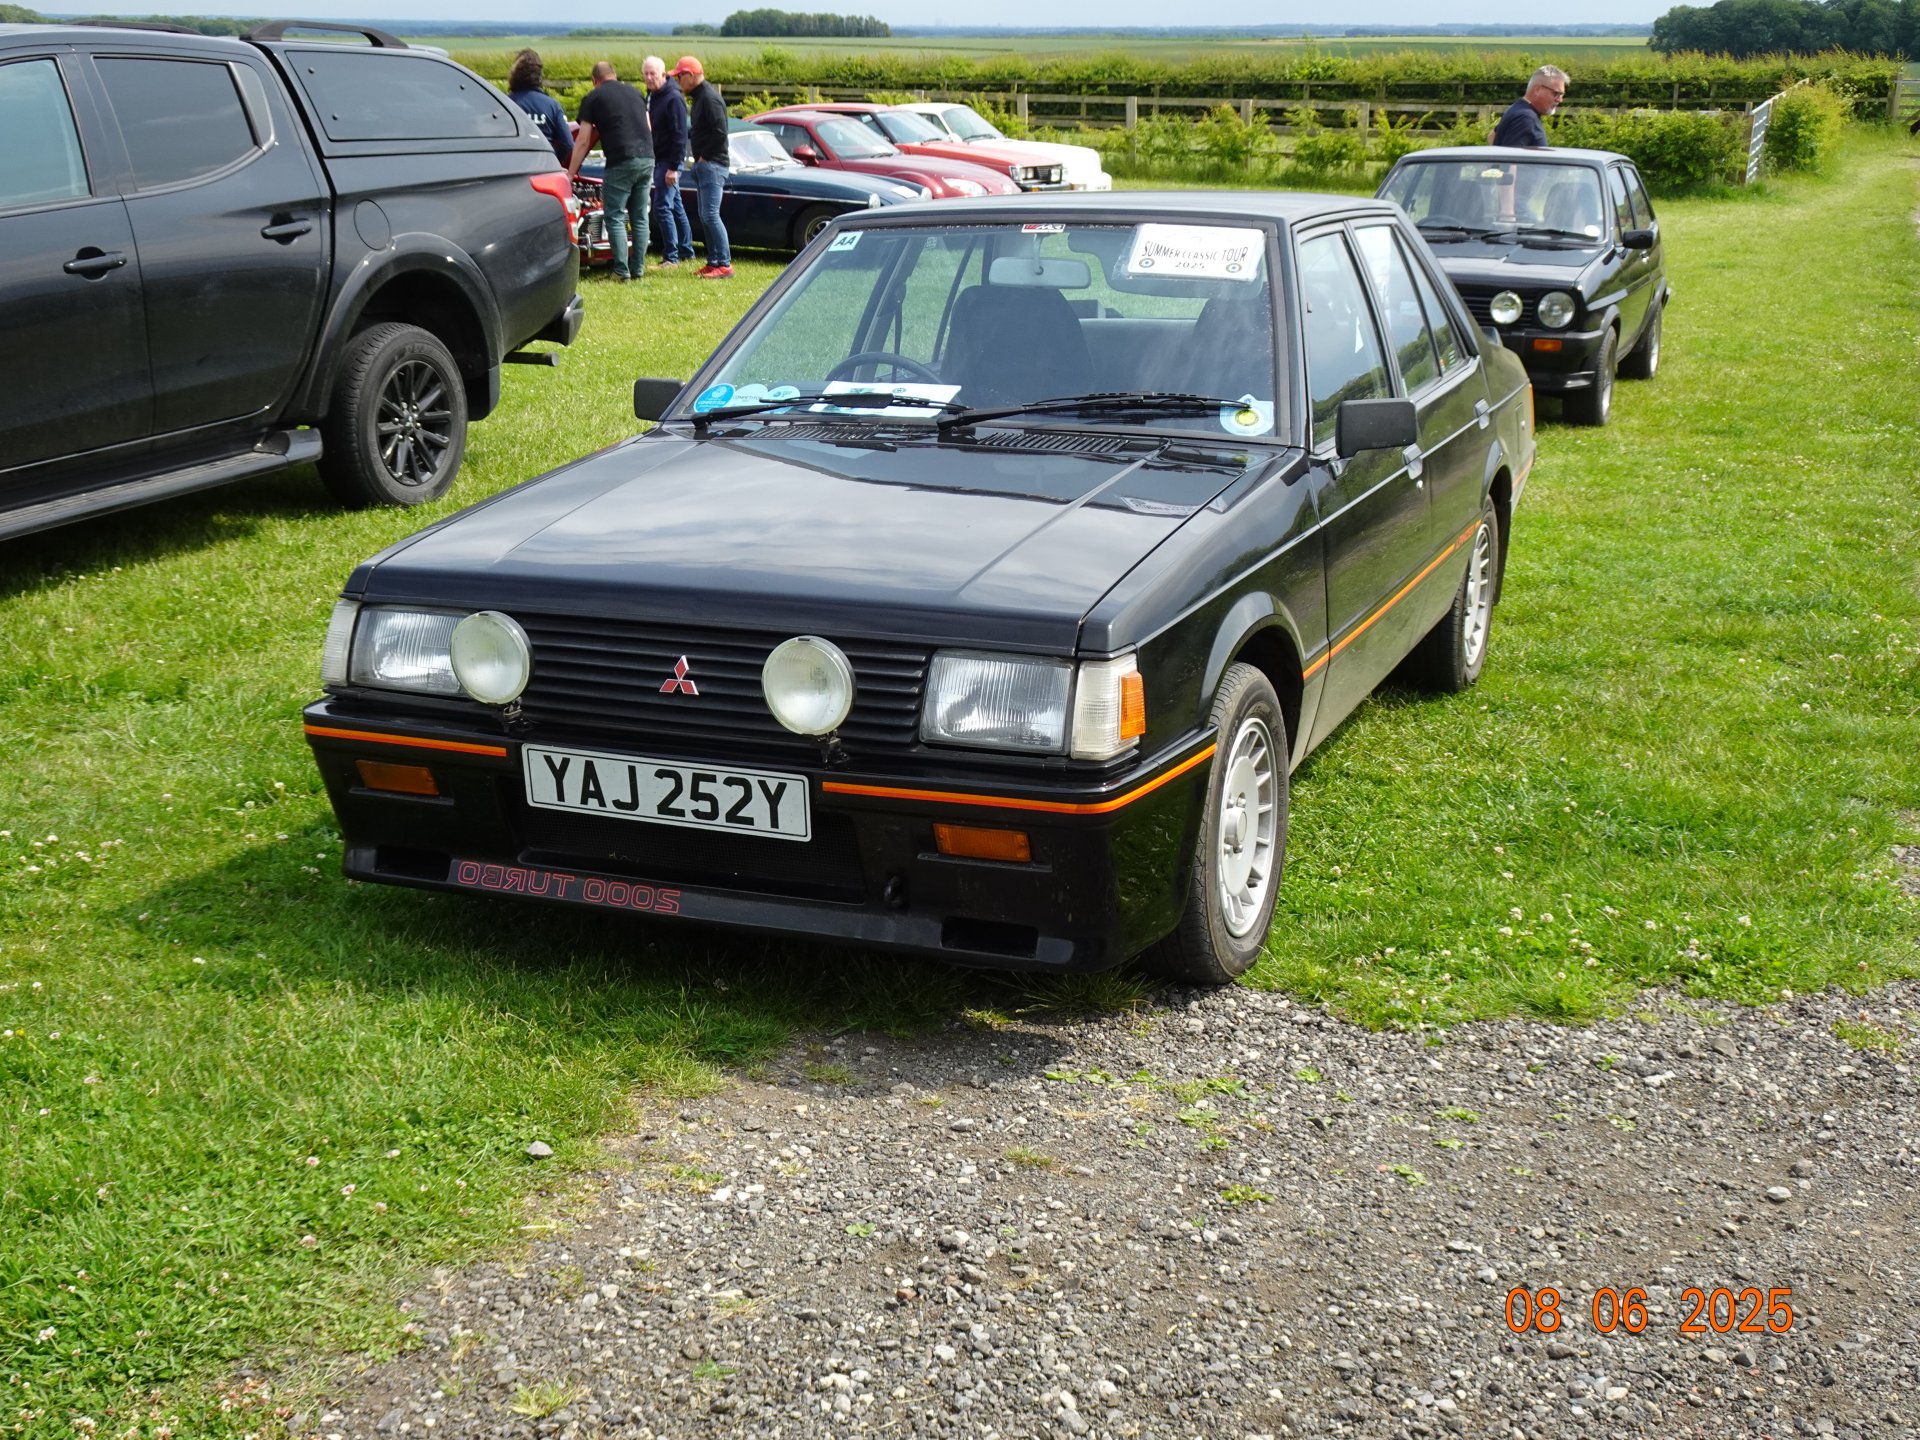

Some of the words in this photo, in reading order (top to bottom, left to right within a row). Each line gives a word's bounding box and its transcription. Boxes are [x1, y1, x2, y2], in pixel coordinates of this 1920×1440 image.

[833, 235, 857, 246] AA
[1142, 241, 1180, 257] SUMMER
[1182, 250, 1219, 261] CLASSIC
[1221, 246, 1249, 262] TOUR
[1175, 261, 1205, 269] 2025
[543, 755, 639, 811] YAJ
[654, 768, 787, 829] 252Y
